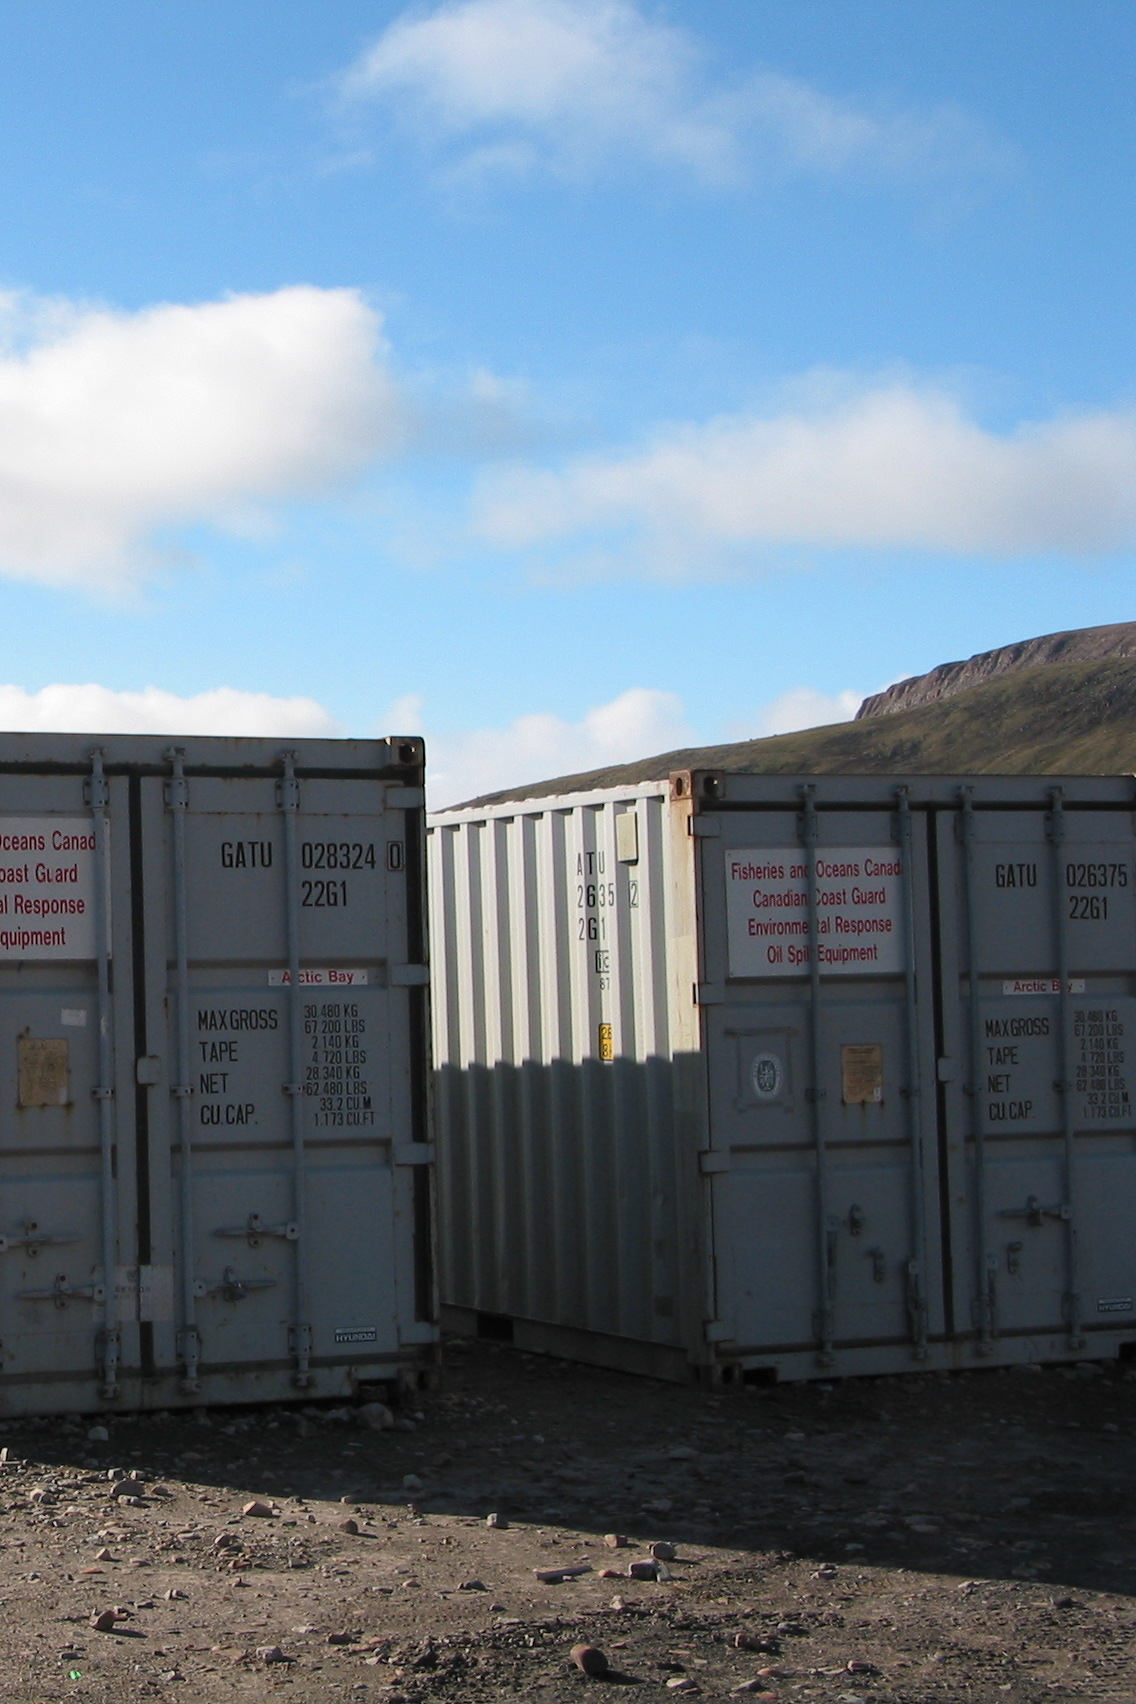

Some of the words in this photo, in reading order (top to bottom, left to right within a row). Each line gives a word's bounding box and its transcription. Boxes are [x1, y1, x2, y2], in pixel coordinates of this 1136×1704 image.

[52, 830, 98, 851] Canad
[221, 841, 273, 868] GATU
[301, 842, 377, 869] 028324
[731, 862, 785, 880] Fisheries
[815, 859, 861, 878] Oceans
[864, 858, 902, 877] Canad
[995, 863, 1038, 888] GATU
[1066, 863, 1129, 888] 026375
[301, 880, 348, 907] 22G1
[753, 889, 808, 908] Canadian
[851, 887, 886, 905] Guard
[14, 895, 86, 918] Response
[1069, 896, 1108, 920] 22G1
[748, 918, 831, 936] Environmetal
[835, 916, 893, 936] Response
[767, 945, 783, 964] Oil
[787, 944, 810, 966] Spil
[818, 944, 878, 965] Equipment
[281, 971, 322, 984] Actic
[328, 970, 355, 985] Bay
[1014, 981, 1047, 993] Arctic
[1052, 980, 1073, 993] By
[344, 1005, 358, 1017] KG
[305, 1020, 317, 1033] 67
[322, 1020, 341, 1033] 200
[344, 1020, 365, 1033] LBS
[345, 1035, 359, 1048] KG
[199, 1041, 238, 1062] TAPE
[345, 1051, 366, 1064] LBS
[987, 1047, 1018, 1065] TAPE
[200, 1072, 228, 1094] NET
[346, 1081, 367, 1094] LBS
[346, 1066, 360, 1079] KG
[988, 1075, 1011, 1093] NET
